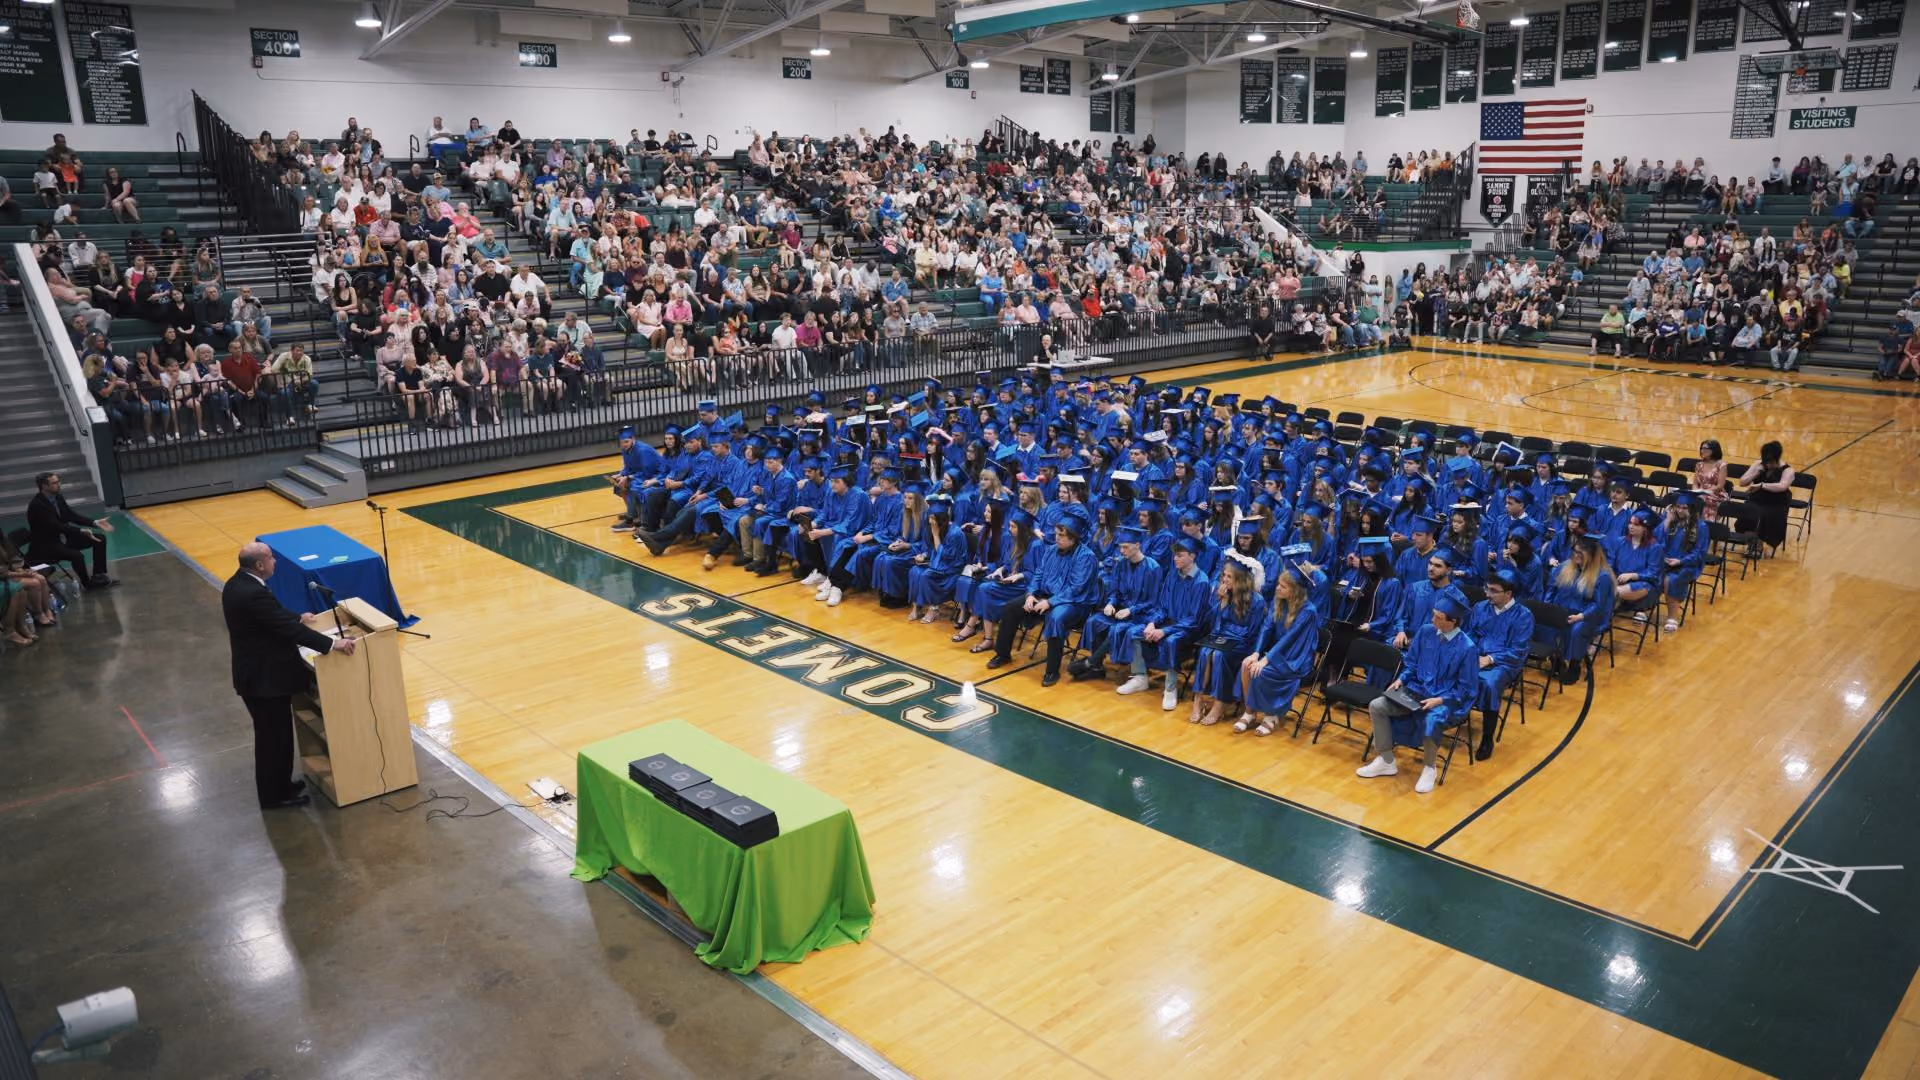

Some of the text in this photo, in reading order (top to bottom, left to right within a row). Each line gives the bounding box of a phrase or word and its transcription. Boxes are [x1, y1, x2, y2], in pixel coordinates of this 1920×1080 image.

[253, 31, 296, 40] SECTION
[264, 41, 292, 54] 400
[521, 45, 555, 53] SECTION
[790, 67, 806, 78] 200
[951, 78, 964, 87] 100
[1801, 108, 1847, 118] VISITING
[1793, 118, 1851, 128] STUDENTS
[637, 592, 999, 732] COMETS
